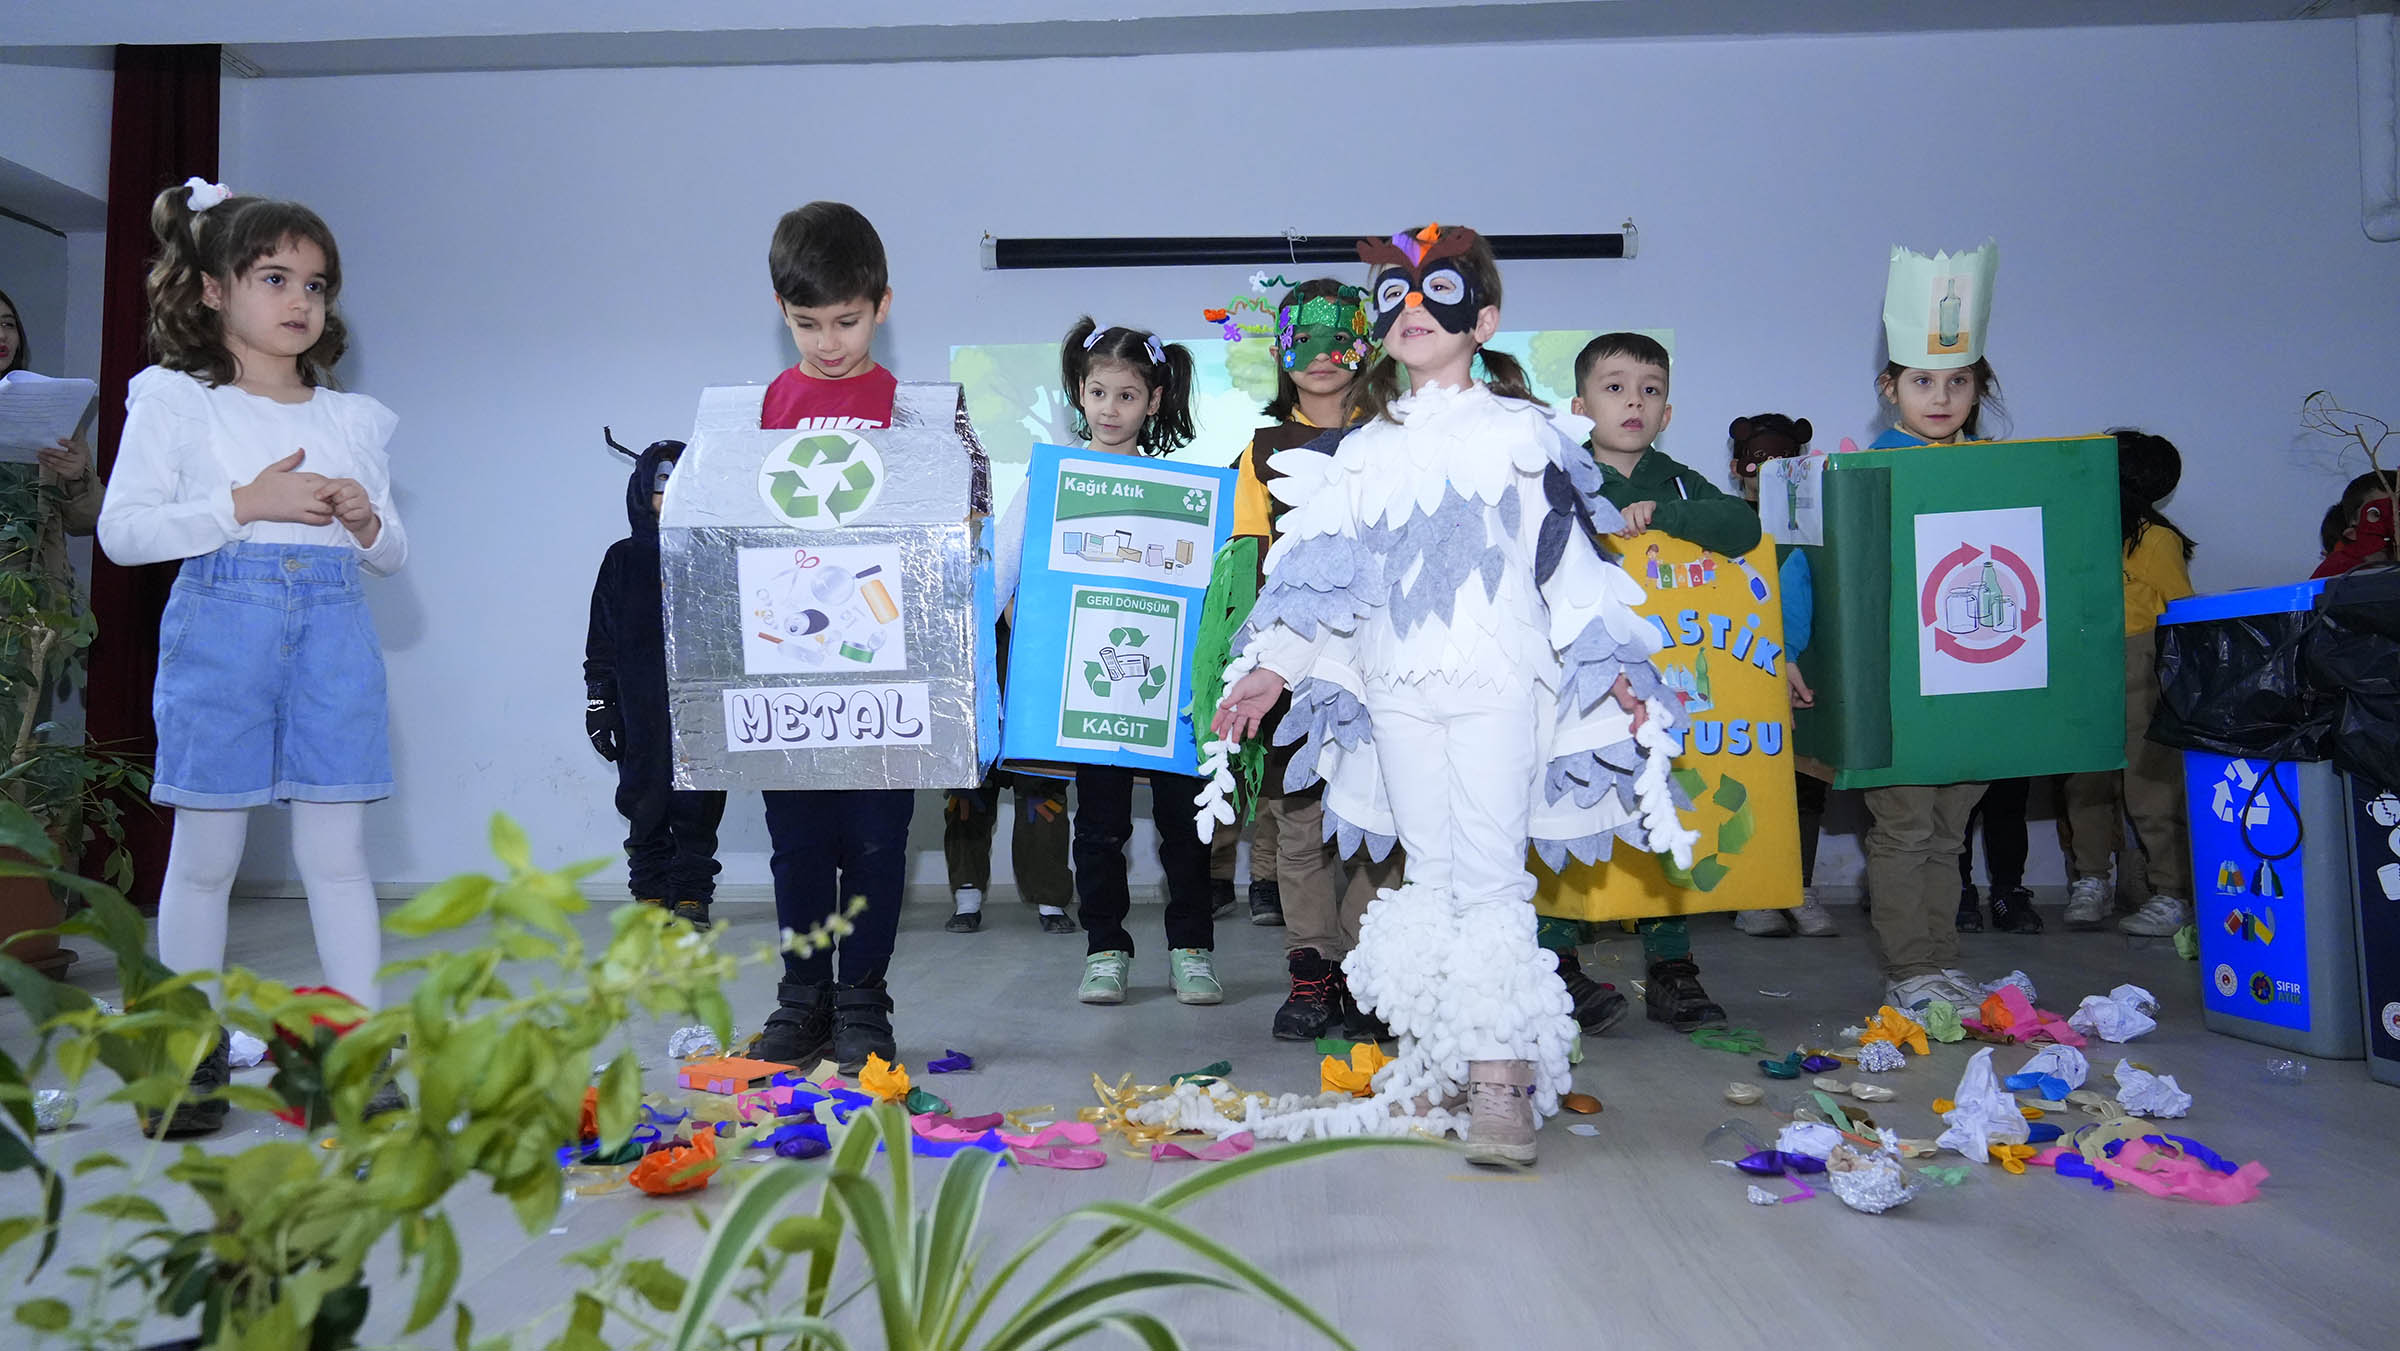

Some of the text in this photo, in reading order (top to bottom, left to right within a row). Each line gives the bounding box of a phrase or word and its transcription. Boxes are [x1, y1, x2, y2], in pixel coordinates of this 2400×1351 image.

[1064, 476, 1145, 498] Kağıt Atık
[1087, 594, 1170, 614] GERİ DÖNÜŞÜM
[1646, 609, 1783, 677] ASTİK
[732, 688, 923, 744] METAL
[1082, 716, 1149, 739] KAĞIT
[1663, 718, 1783, 756] TUSU
[2276, 980, 2301, 994] SIFIR
